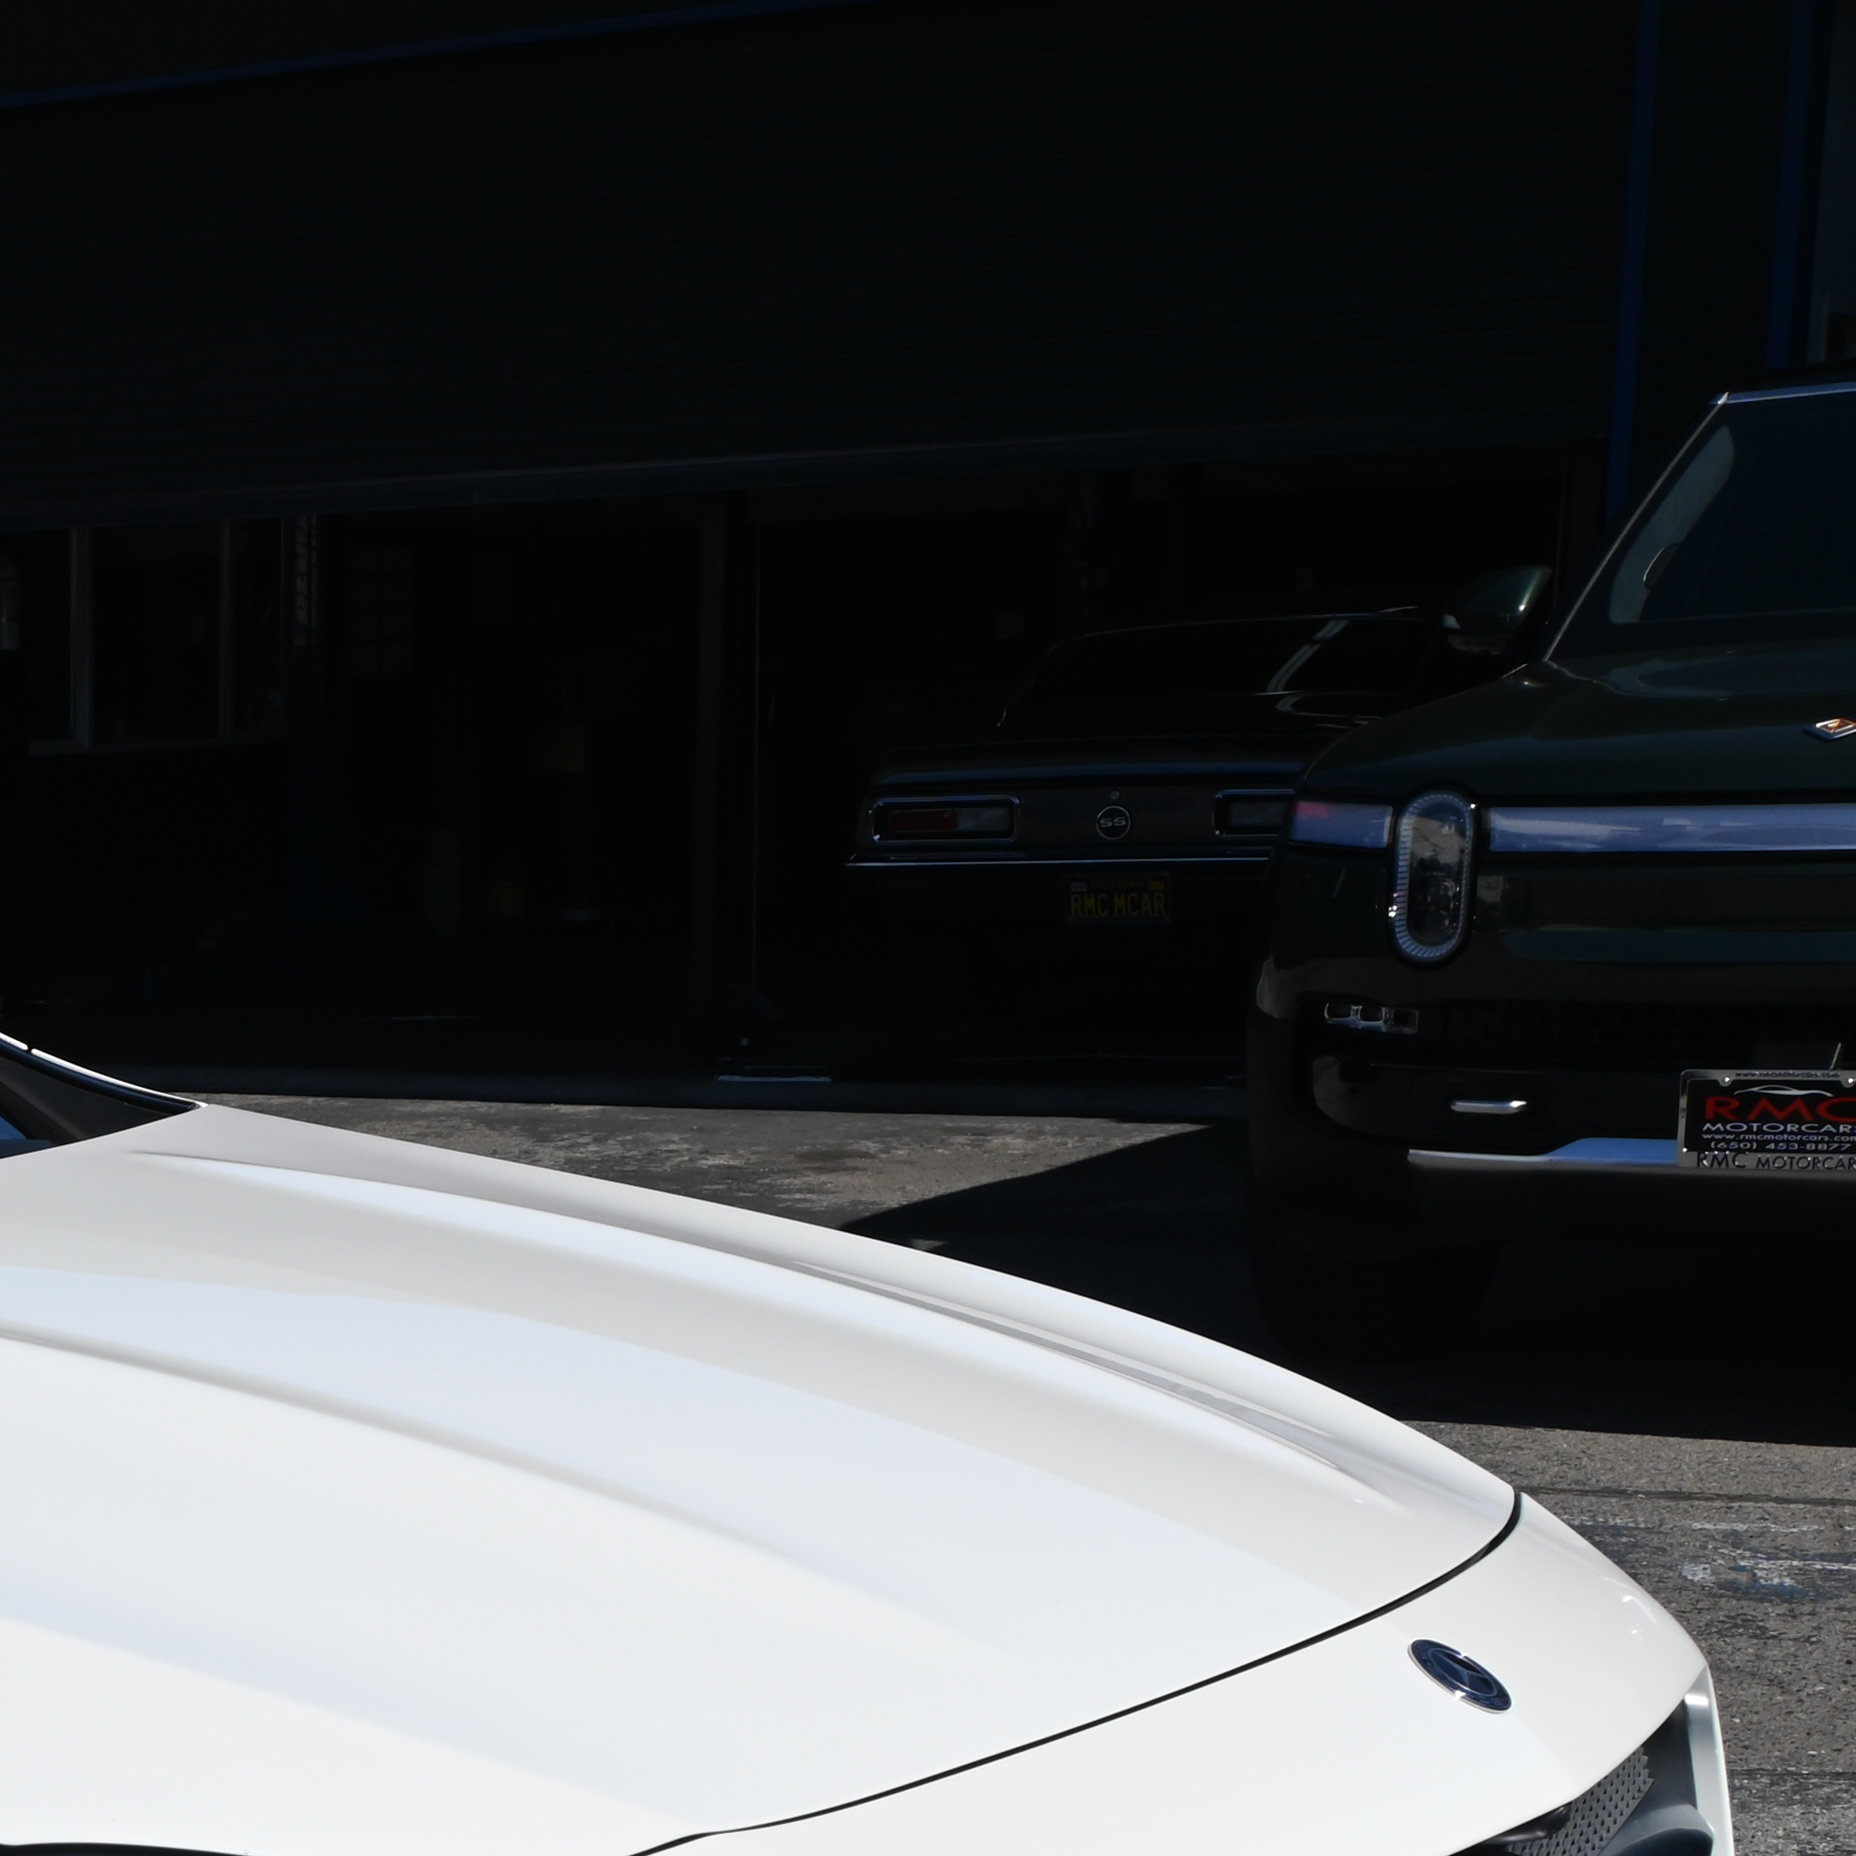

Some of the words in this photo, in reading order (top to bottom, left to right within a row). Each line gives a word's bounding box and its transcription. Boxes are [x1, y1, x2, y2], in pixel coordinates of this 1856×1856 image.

[1703, 1095, 1856, 1122] RMC
[1710, 1140, 1757, 1151] (650)
[1764, 1141, 1852, 1152] 453-8877
[1696, 1151, 1747, 1169] RMC
